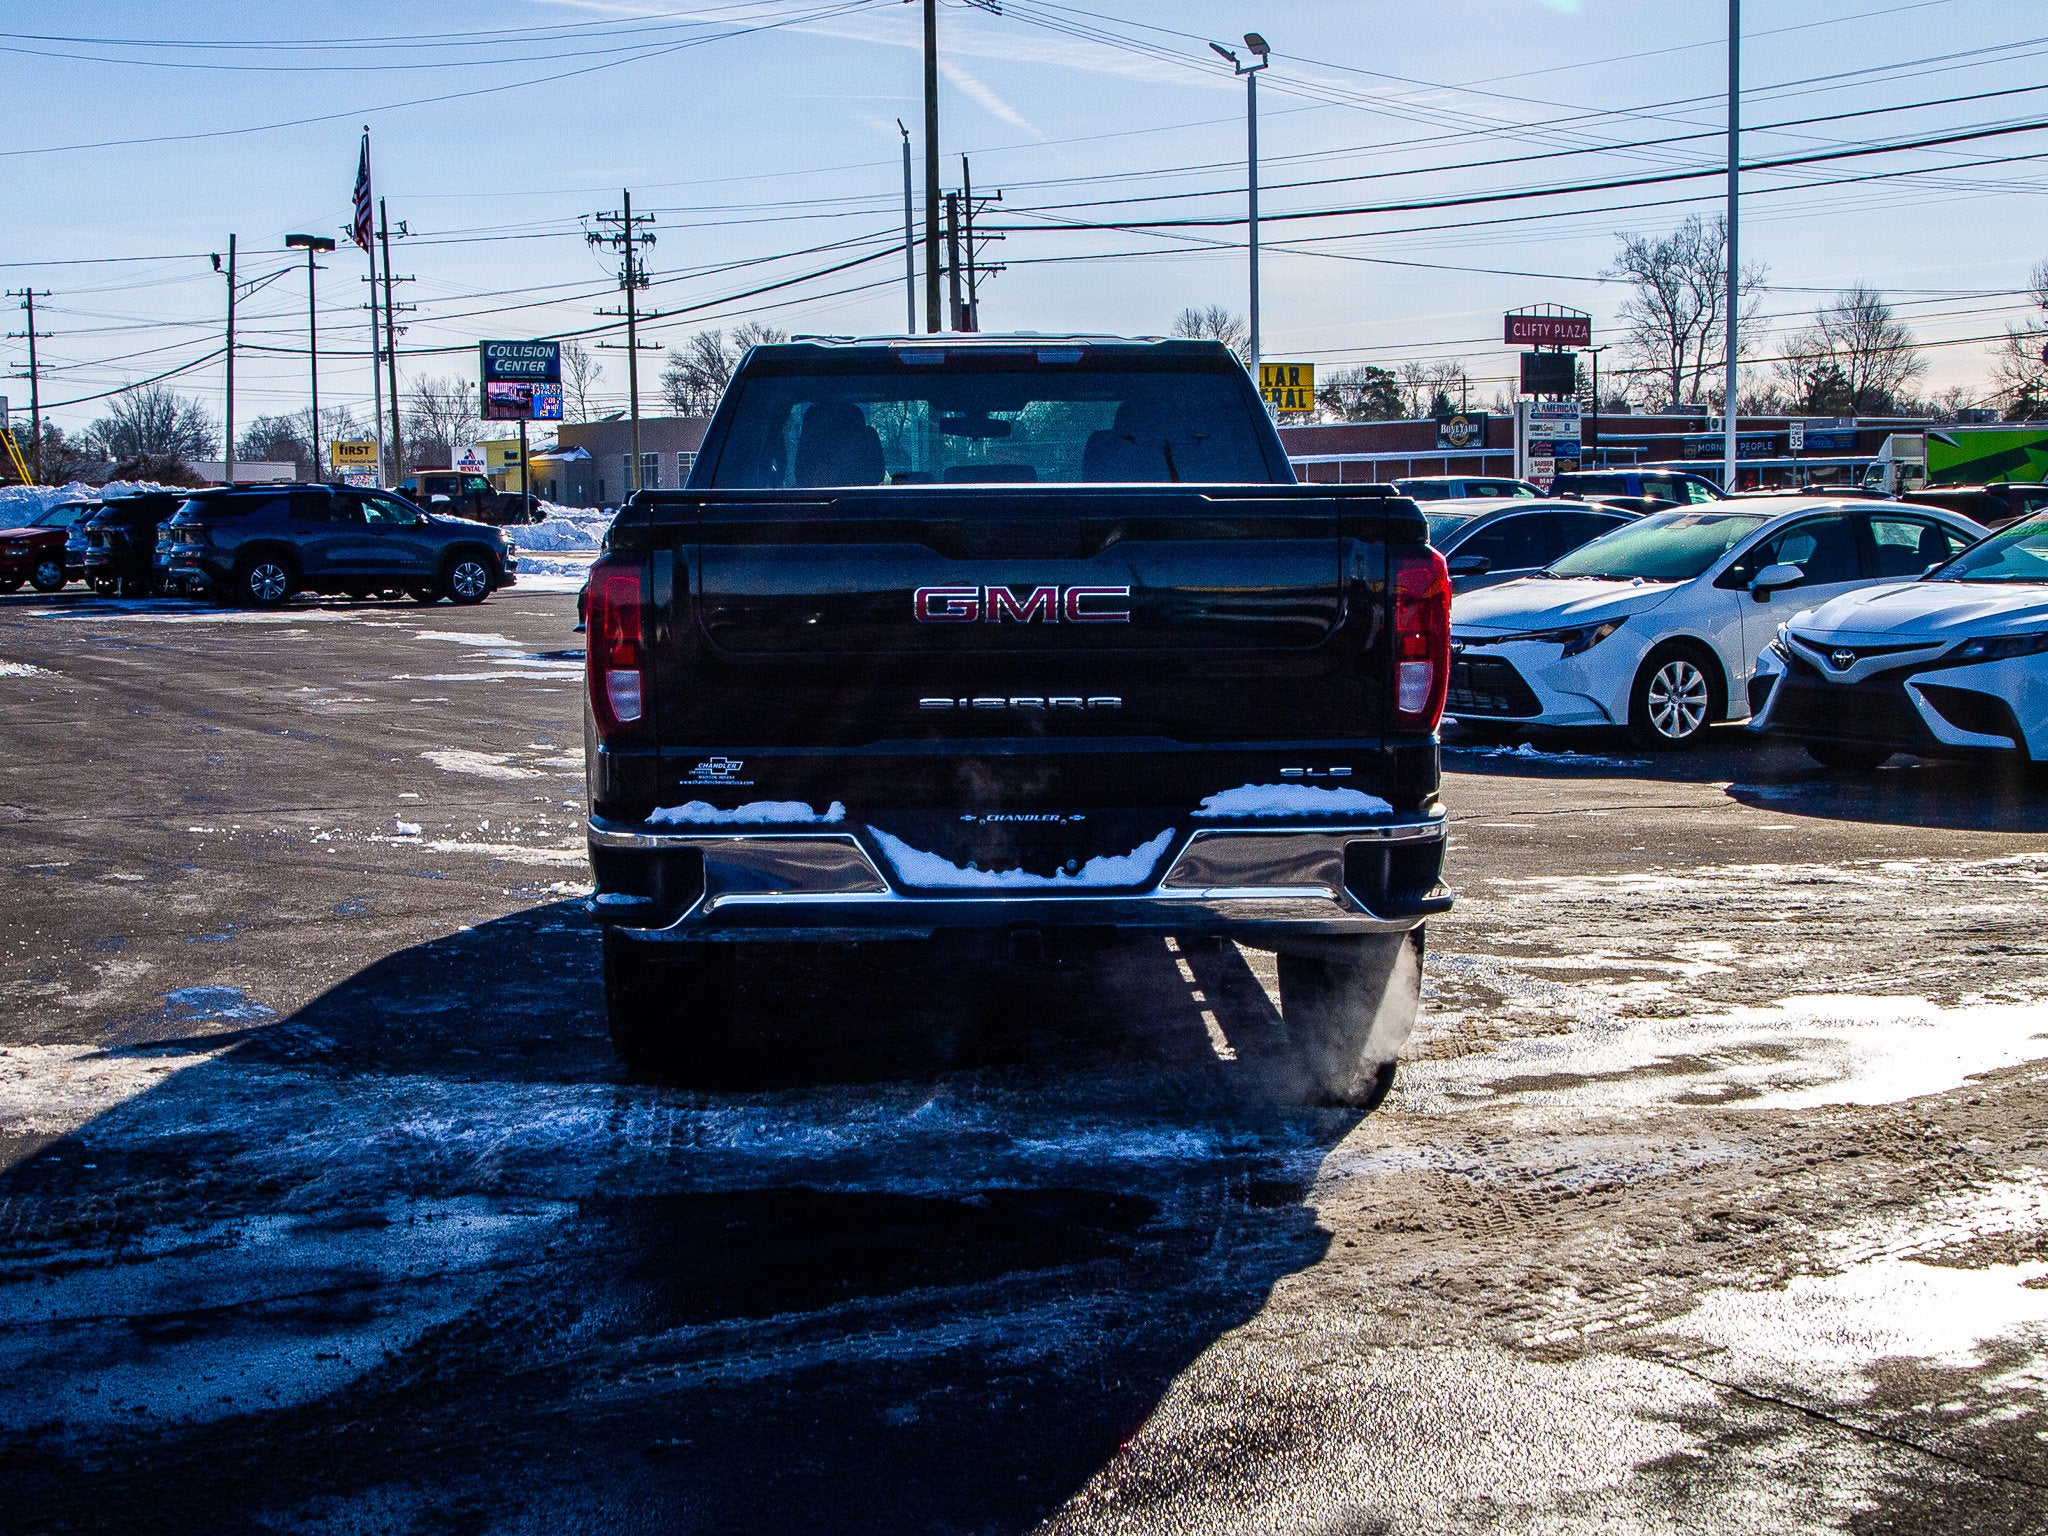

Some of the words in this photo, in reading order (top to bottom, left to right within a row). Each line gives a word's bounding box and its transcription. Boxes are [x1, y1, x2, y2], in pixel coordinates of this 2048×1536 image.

[1513, 322, 1550, 337] CLIFTY
[1554, 324, 1588, 338] PLAZA
[488, 344, 555, 358] COLLISION
[494, 359, 546, 372] CENTER
[1541, 403, 1579, 412] AMERICAN
[1698, 443, 1726, 452] MORNI
[1740, 442, 1773, 450] PEOPLE
[1790, 436, 1803, 447] 35
[914, 585, 1131, 624] GMC
[919, 697, 1122, 710] SIERRA
